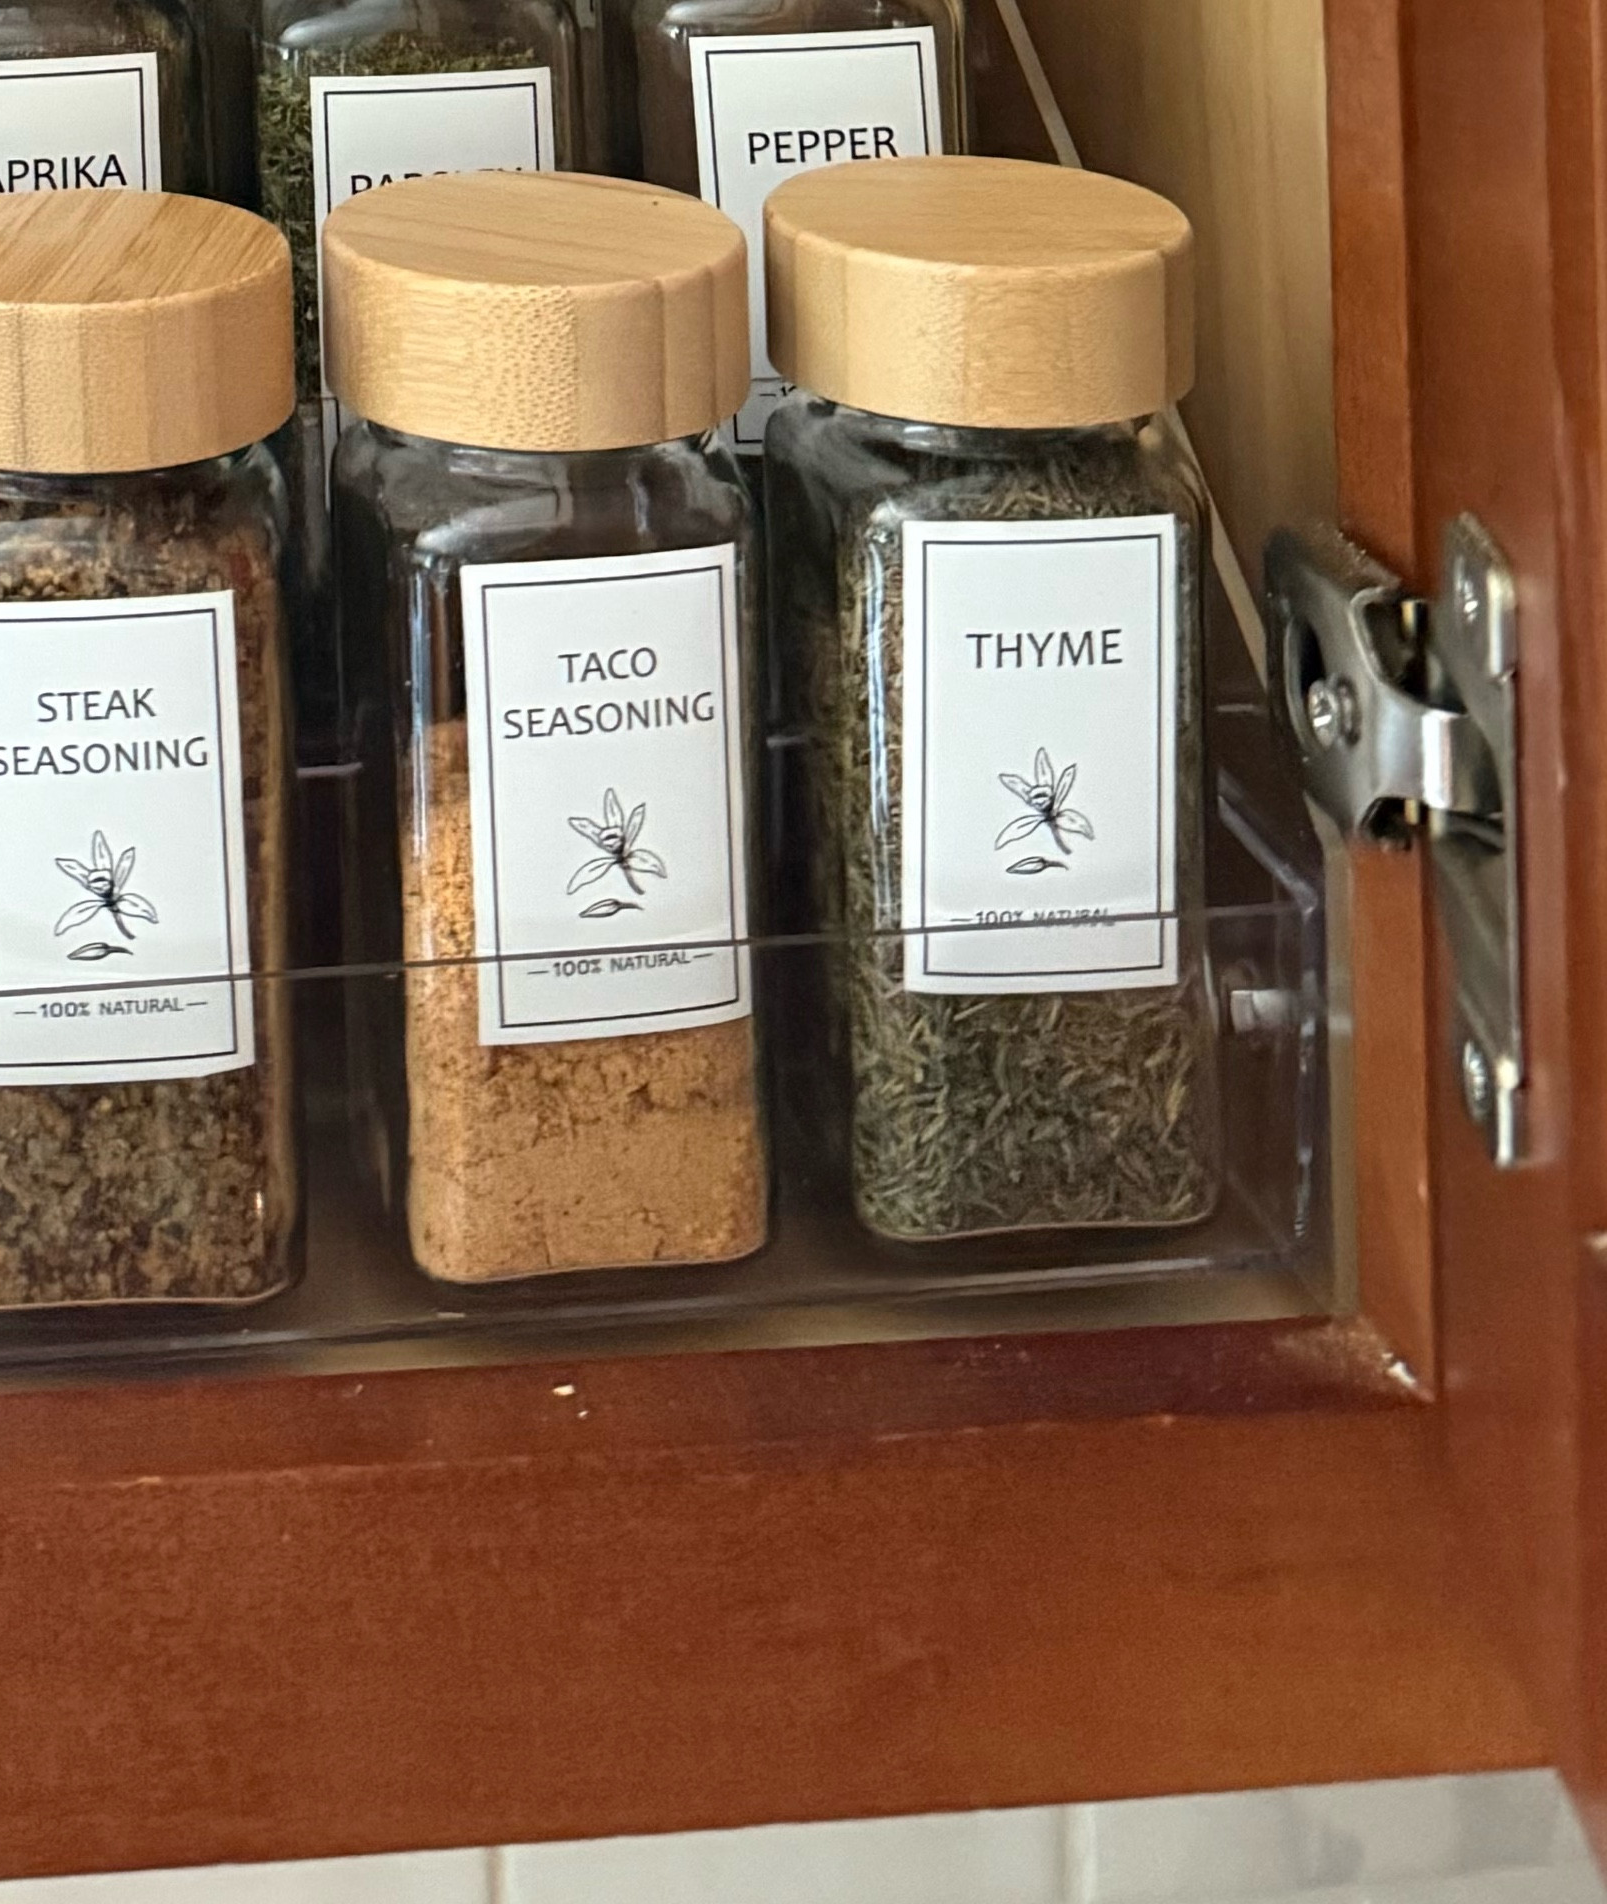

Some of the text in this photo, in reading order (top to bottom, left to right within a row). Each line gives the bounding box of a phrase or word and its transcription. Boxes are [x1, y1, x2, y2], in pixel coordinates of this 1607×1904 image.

[747, 126, 899, 164] PEPPER
[557, 647, 659, 684] TACO
[965, 628, 1124, 669] THYME
[36, 687, 158, 723] STEAK
[503, 691, 715, 740] SEASONING
[553, 950, 691, 977] 100% NATURAL
[40, 998, 184, 1018] 100% NATURAL
